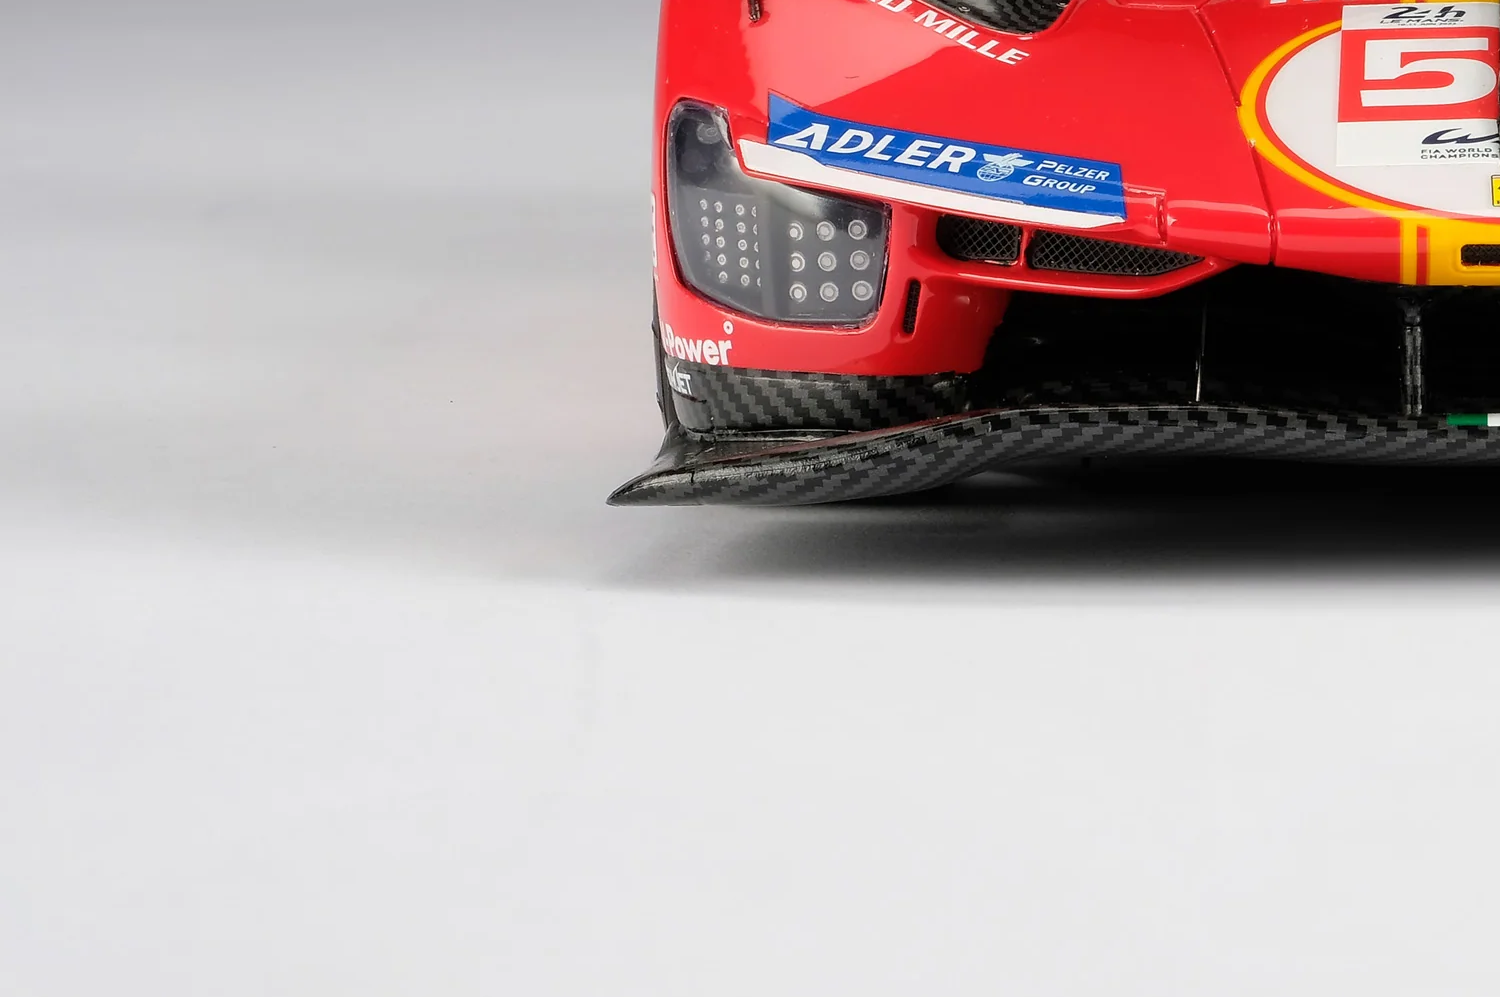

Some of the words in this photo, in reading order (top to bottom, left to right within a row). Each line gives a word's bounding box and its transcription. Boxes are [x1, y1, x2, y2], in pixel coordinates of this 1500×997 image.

[913, 8, 1030, 66] MILLE
[773, 122, 978, 174] ADLER
[1022, 174, 1097, 196] GROUP
[1036, 159, 1111, 182] PELZER
